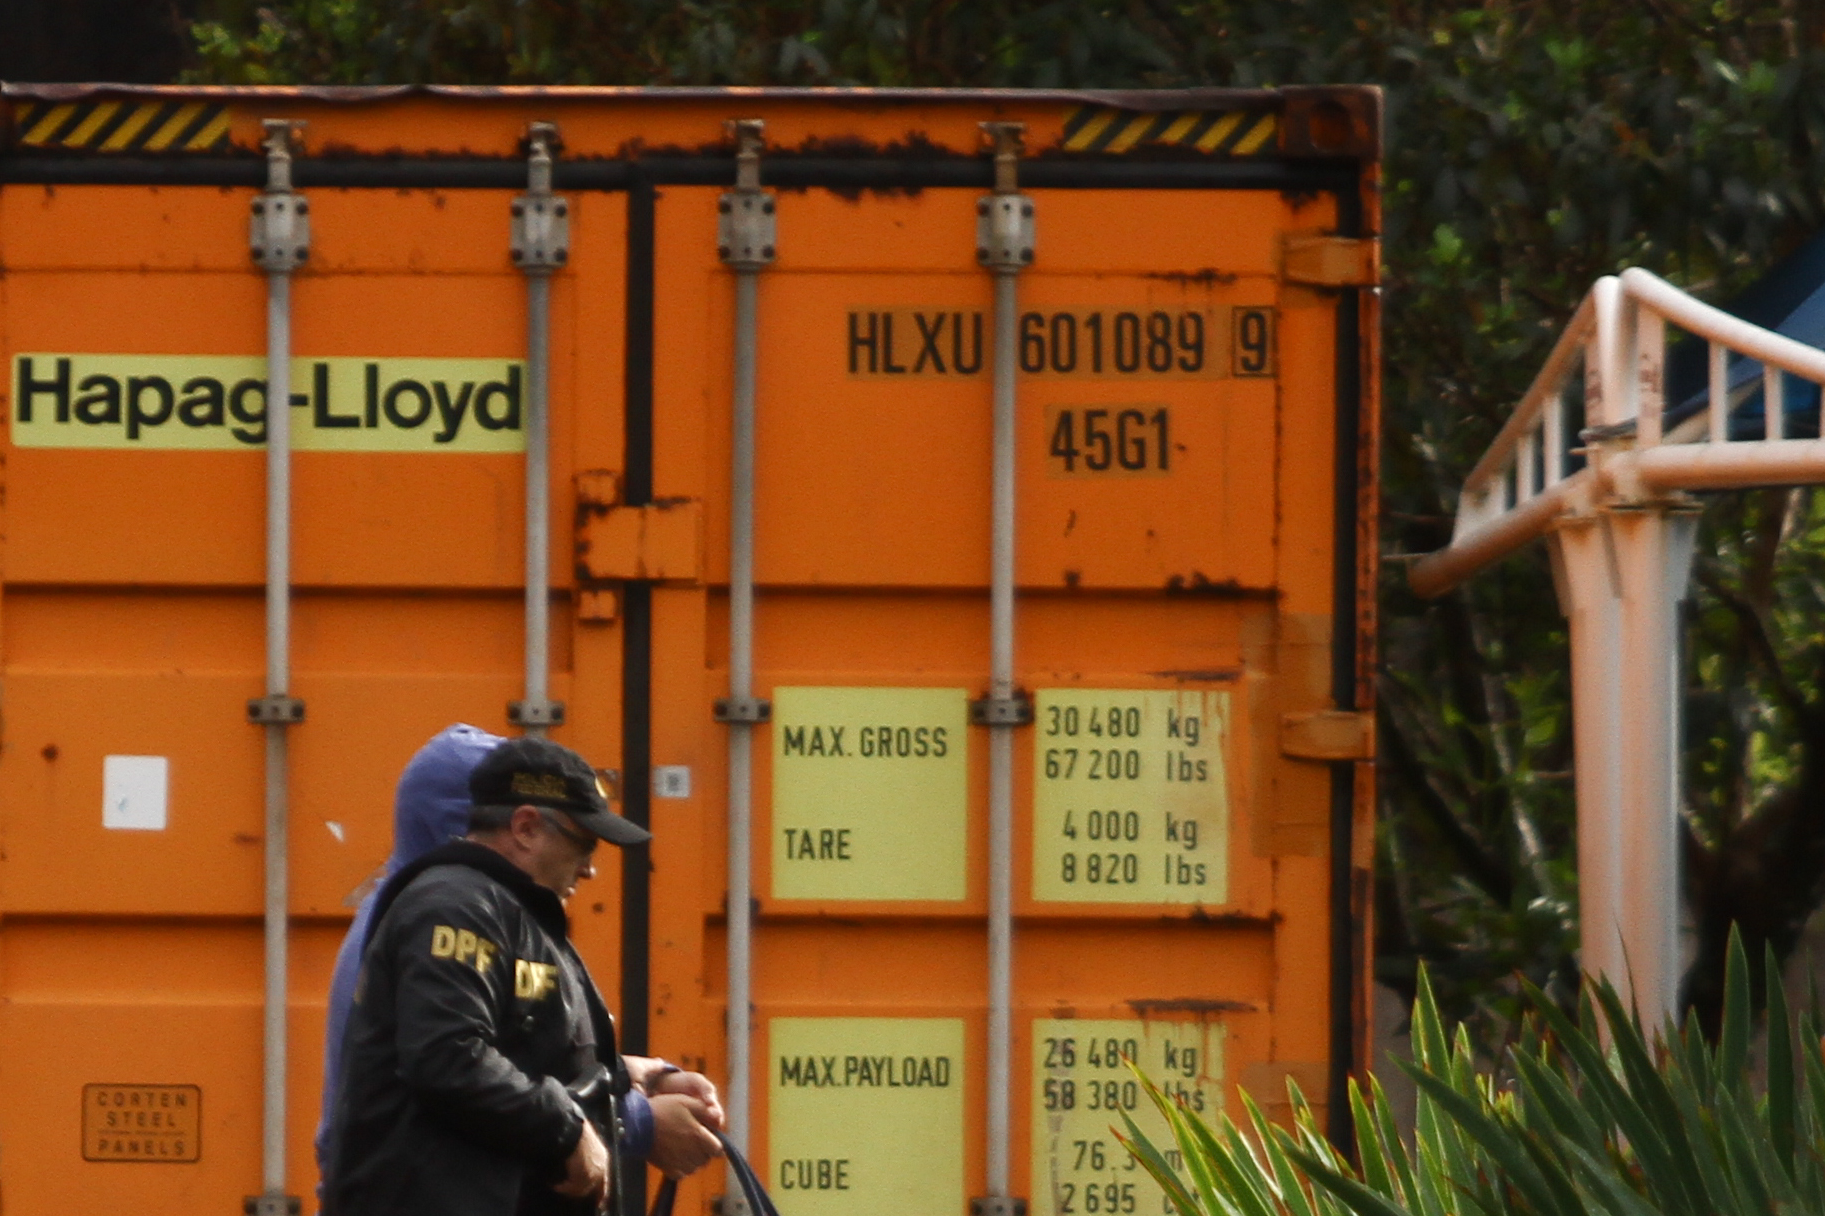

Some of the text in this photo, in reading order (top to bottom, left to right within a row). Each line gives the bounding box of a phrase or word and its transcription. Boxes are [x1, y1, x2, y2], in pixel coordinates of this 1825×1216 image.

[847, 311, 1268, 374] HLXU 601089 9
[16, 357, 522, 444] Hapag-Lloyd
[1049, 408, 1170, 471] 45G1
[859, 725, 948, 759] GROSS
[1167, 707, 1201, 747] kg
[1166, 750, 1208, 782] lbs
[784, 828, 852, 861] TARE
[1165, 811, 1199, 851] kg
[1164, 854, 1207, 886] lbs
[431, 924, 498, 974] DPF
[1163, 1039, 1197, 1078] kg
[106, 1110, 175, 1127] STEEL
[98, 1138, 185, 1156] PANELS
[779, 1158, 850, 1191] CUBE
